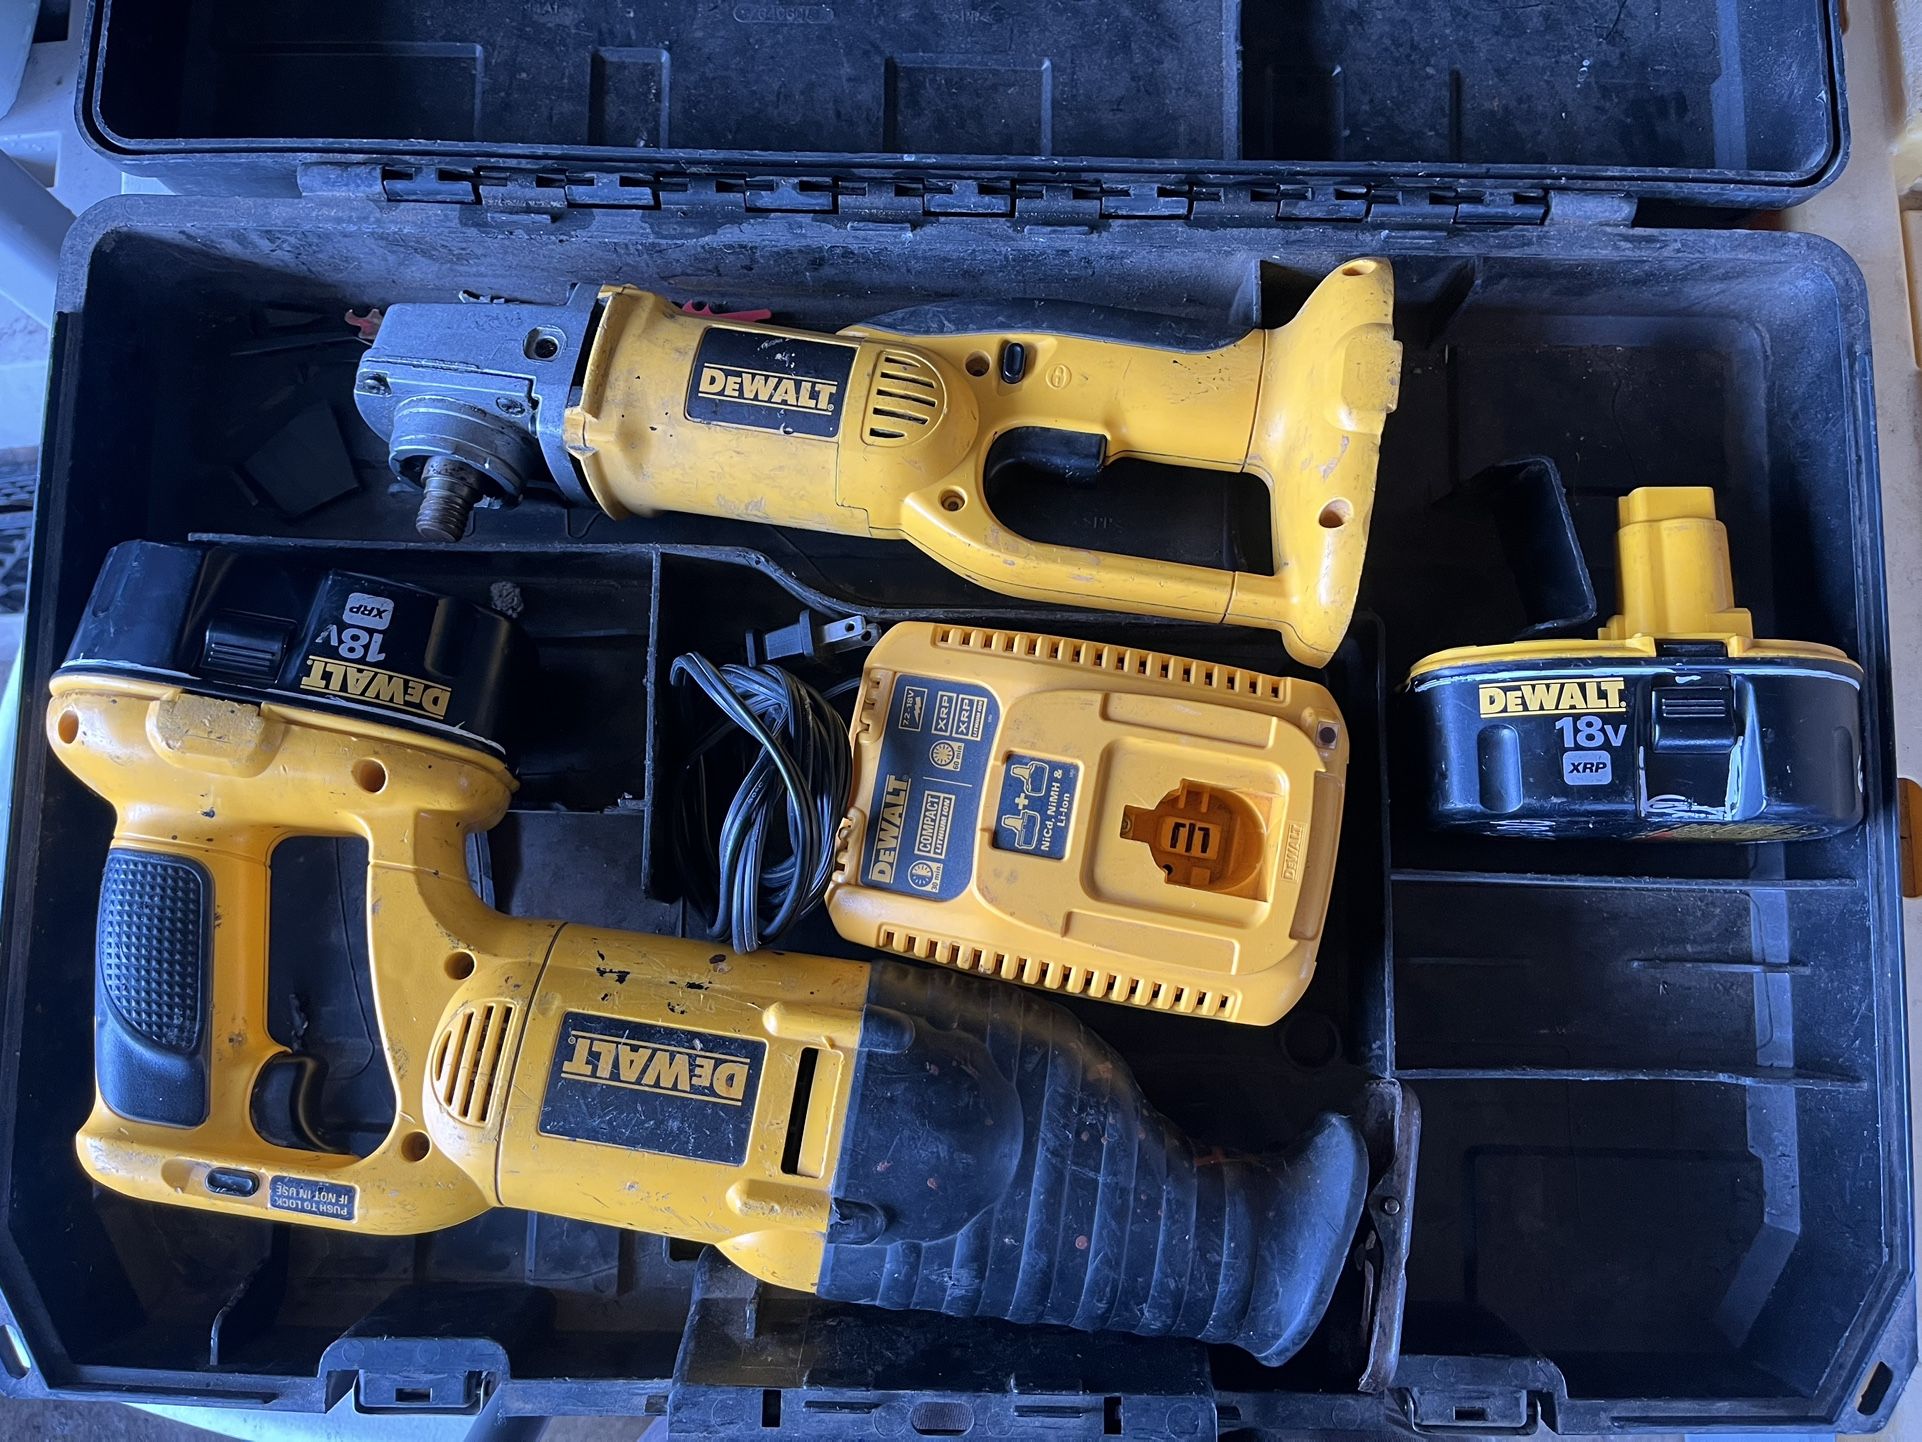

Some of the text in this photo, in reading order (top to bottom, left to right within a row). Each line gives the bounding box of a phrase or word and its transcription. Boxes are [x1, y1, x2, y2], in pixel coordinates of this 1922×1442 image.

[349, 604, 389, 620] XRP
[937, 696, 950, 730] XRP
[958, 699, 971, 734] XRP
[952, 762, 960, 770] 60
[1053, 769, 1063, 778] &
[1568, 761, 1608, 774] XRP
[1047, 782, 1060, 815] NiMH
[1057, 793, 1070, 827] Li-Ion
[919, 795, 939, 852] COMPACT
[935, 798, 951, 853] LITHIUM ION
[931, 882, 938, 891] 30
[276, 1184, 348, 1204] IF NOT IN USE
[276, 1197, 347, 1215] PUSH TO LOCK
